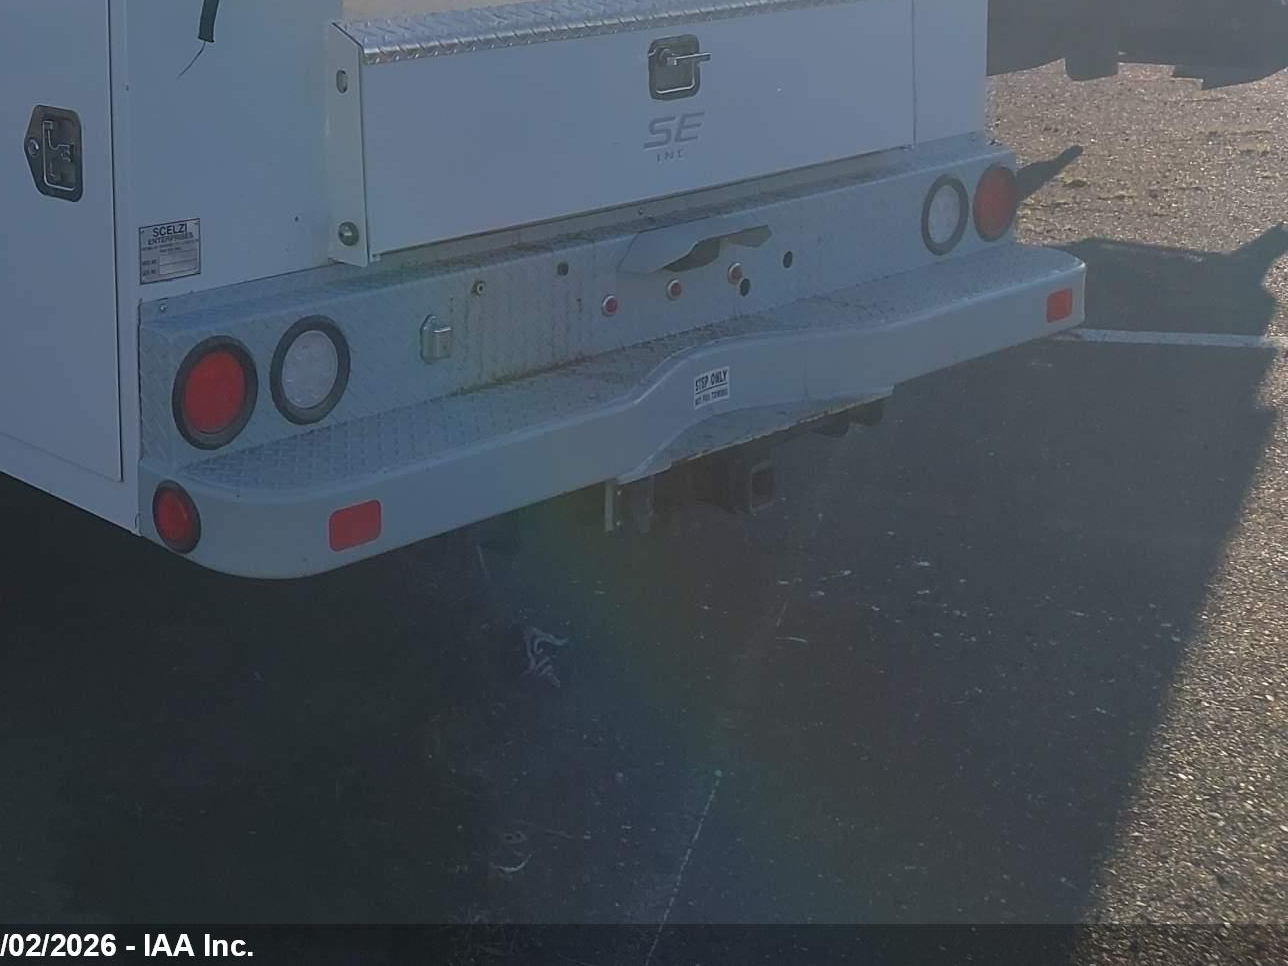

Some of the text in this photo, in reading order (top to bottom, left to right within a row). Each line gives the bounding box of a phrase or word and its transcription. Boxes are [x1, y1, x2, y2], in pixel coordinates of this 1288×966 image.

[643, 112, 705, 149] SE
[152, 223, 188, 237] SCELZI
[695, 369, 728, 391] STEP ONLY
